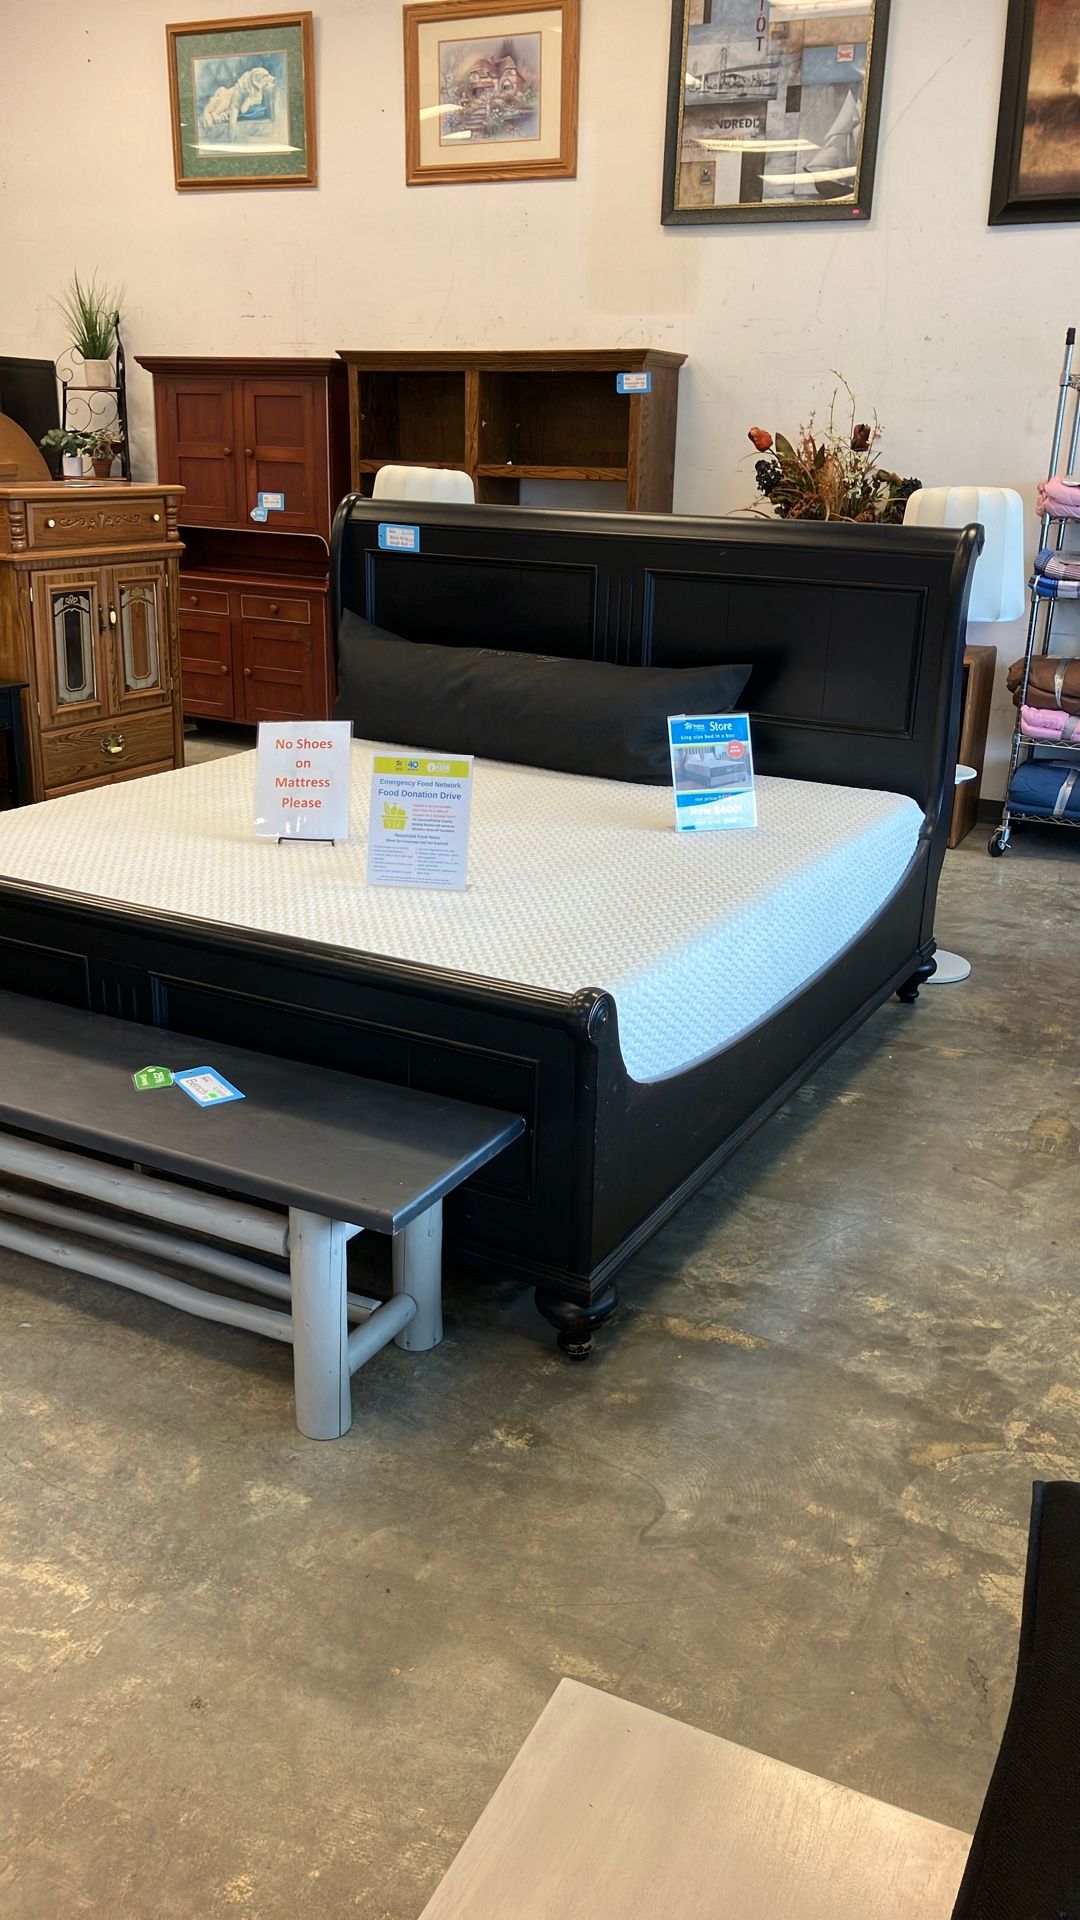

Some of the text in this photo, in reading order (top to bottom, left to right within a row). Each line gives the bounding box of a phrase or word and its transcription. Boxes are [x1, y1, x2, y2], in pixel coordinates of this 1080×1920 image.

[709, 721, 733, 731] Store
[275, 738, 333, 750] No Shoes
[295, 760, 311, 768] on
[407, 761, 419, 769] 40
[275, 777, 330, 788] Mattress
[379, 778, 416, 787] Emergency
[378, 788, 462, 800] Food Donation Drive
[281, 797, 322, 809] Please
